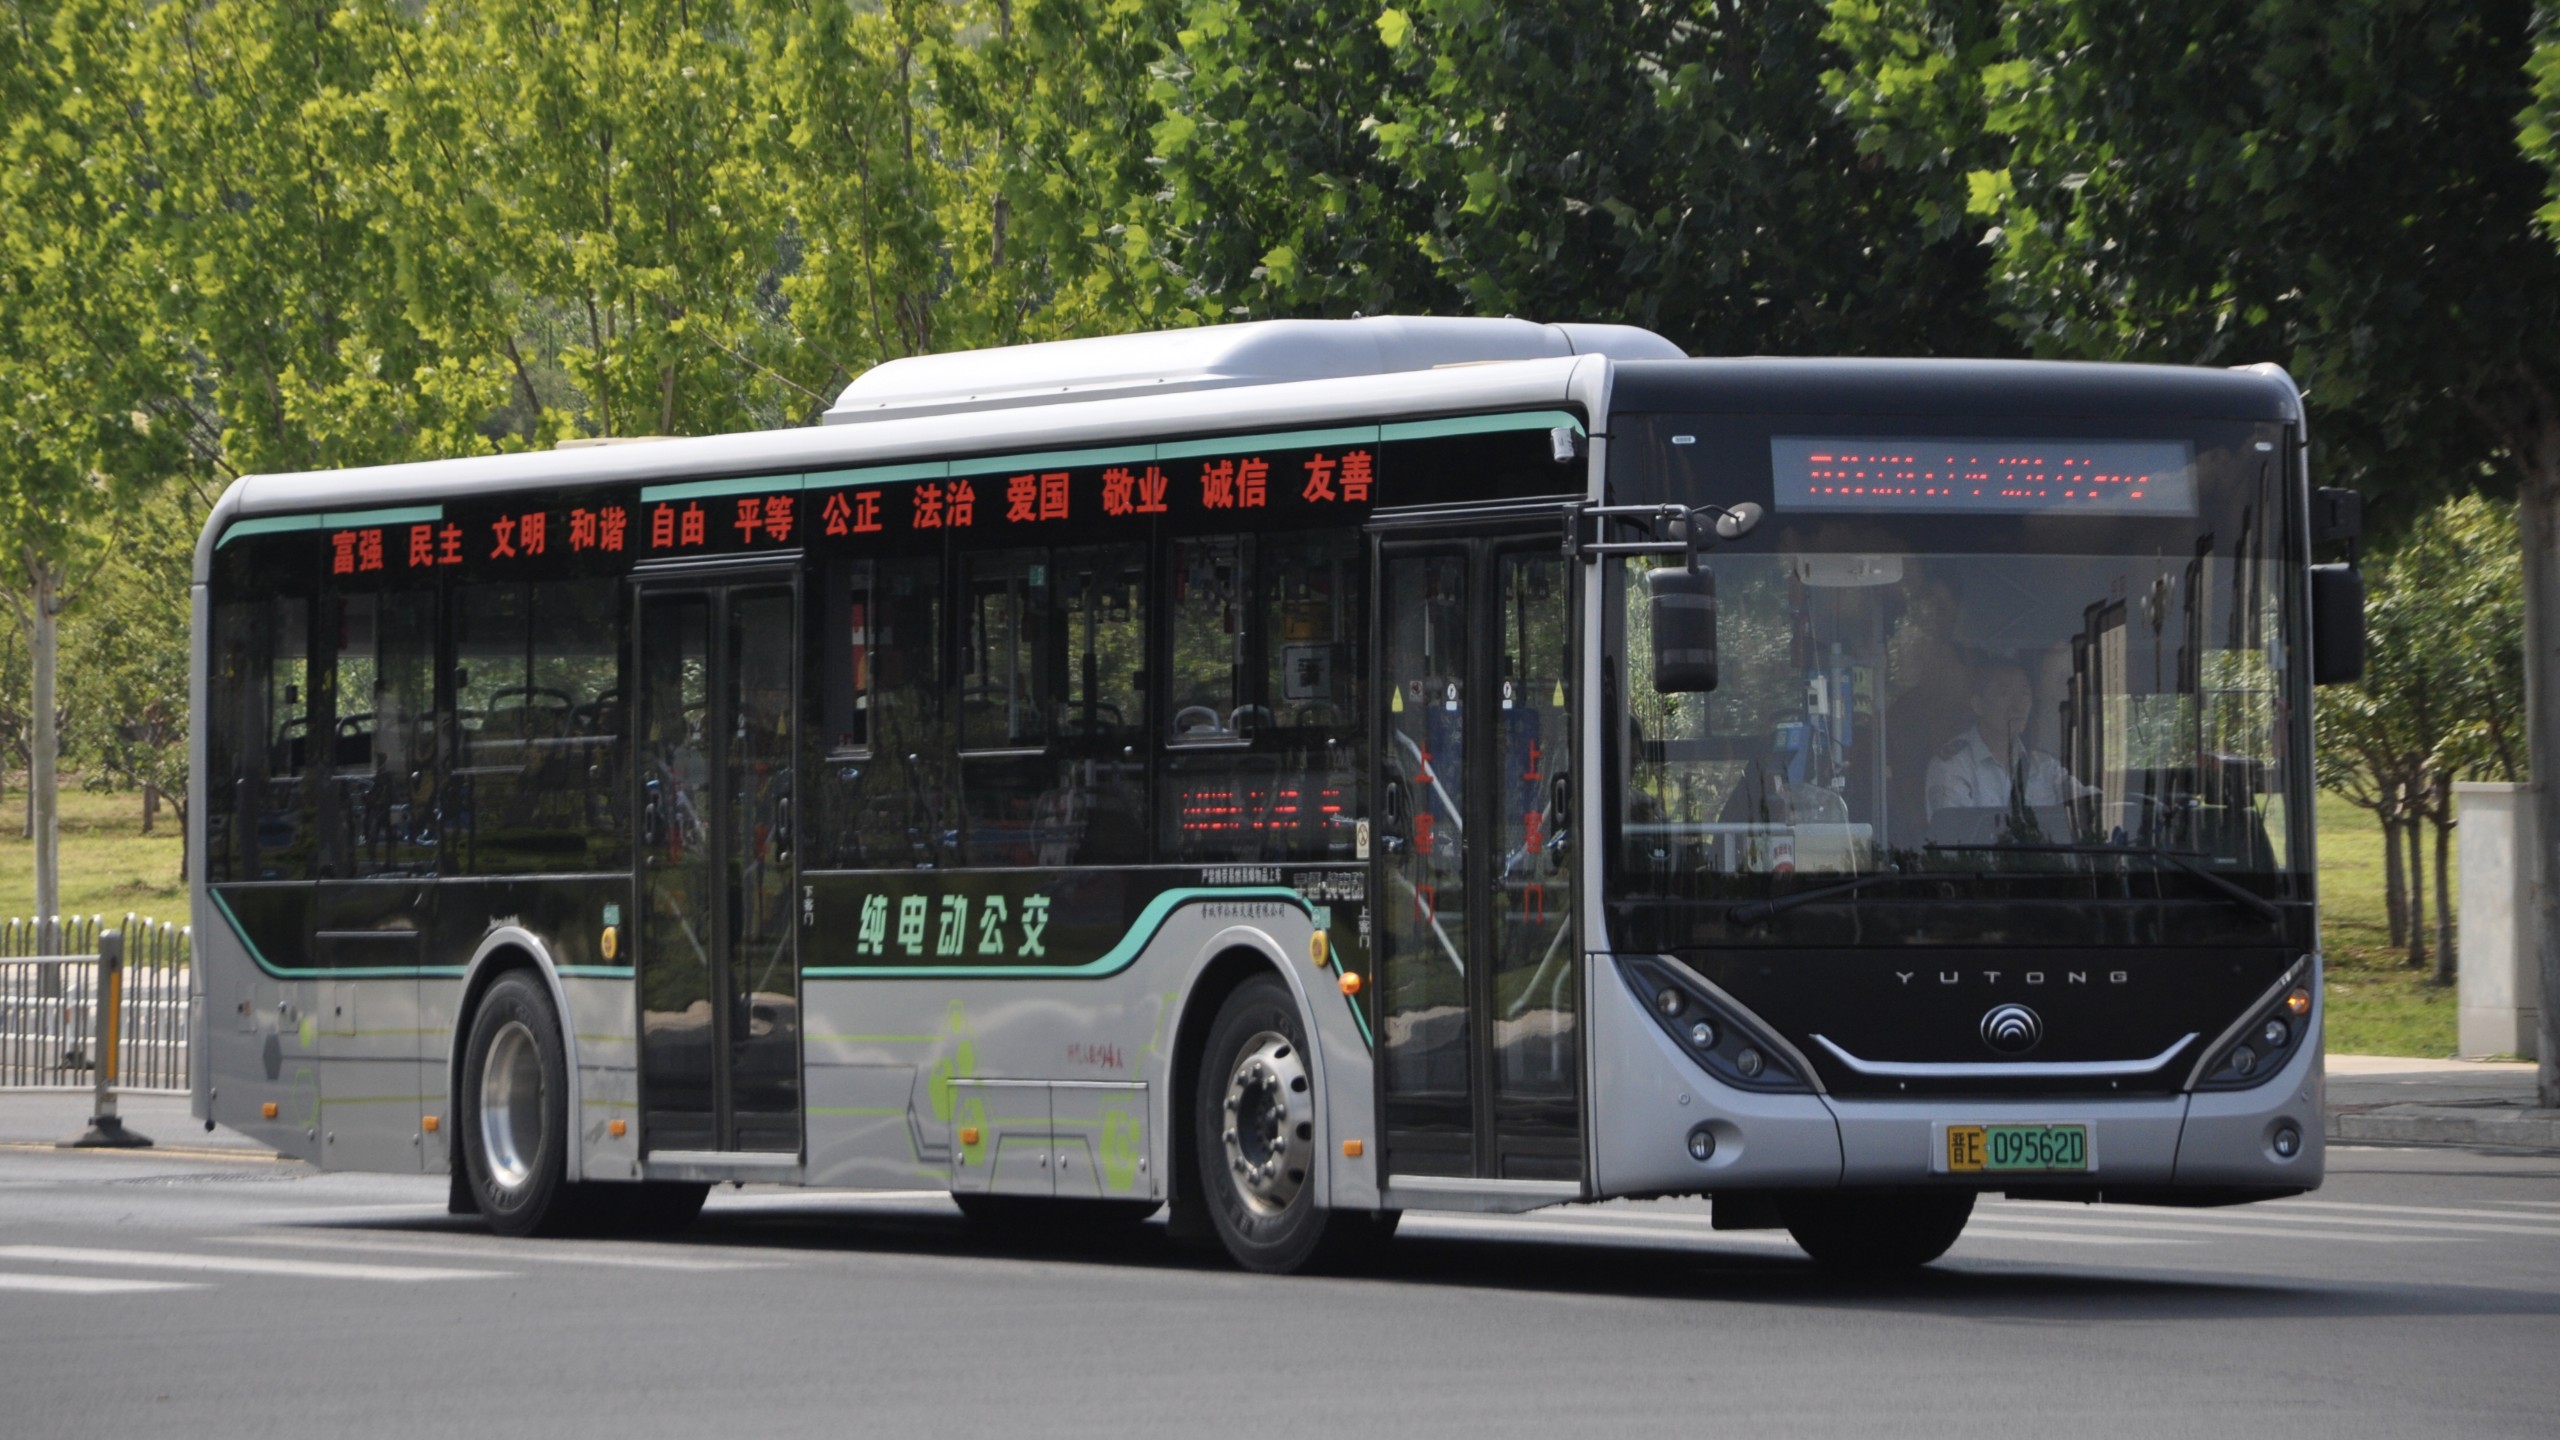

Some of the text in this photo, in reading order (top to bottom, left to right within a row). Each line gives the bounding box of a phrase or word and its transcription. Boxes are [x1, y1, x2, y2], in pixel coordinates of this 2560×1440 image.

[332, 451, 1373, 574] 富强 民主 文明 和谐 自由 平等 公正 法治 爱国 敬业 诚信 友善
[803, 885, 813, 926] 下客门
[857, 894, 1051, 956] 纯电动公交
[1358, 905, 1370, 949] 上客门
[1896, 971, 2128, 984] YUTONG
[1951, 1131, 2084, 1165] 晋E 09562D
